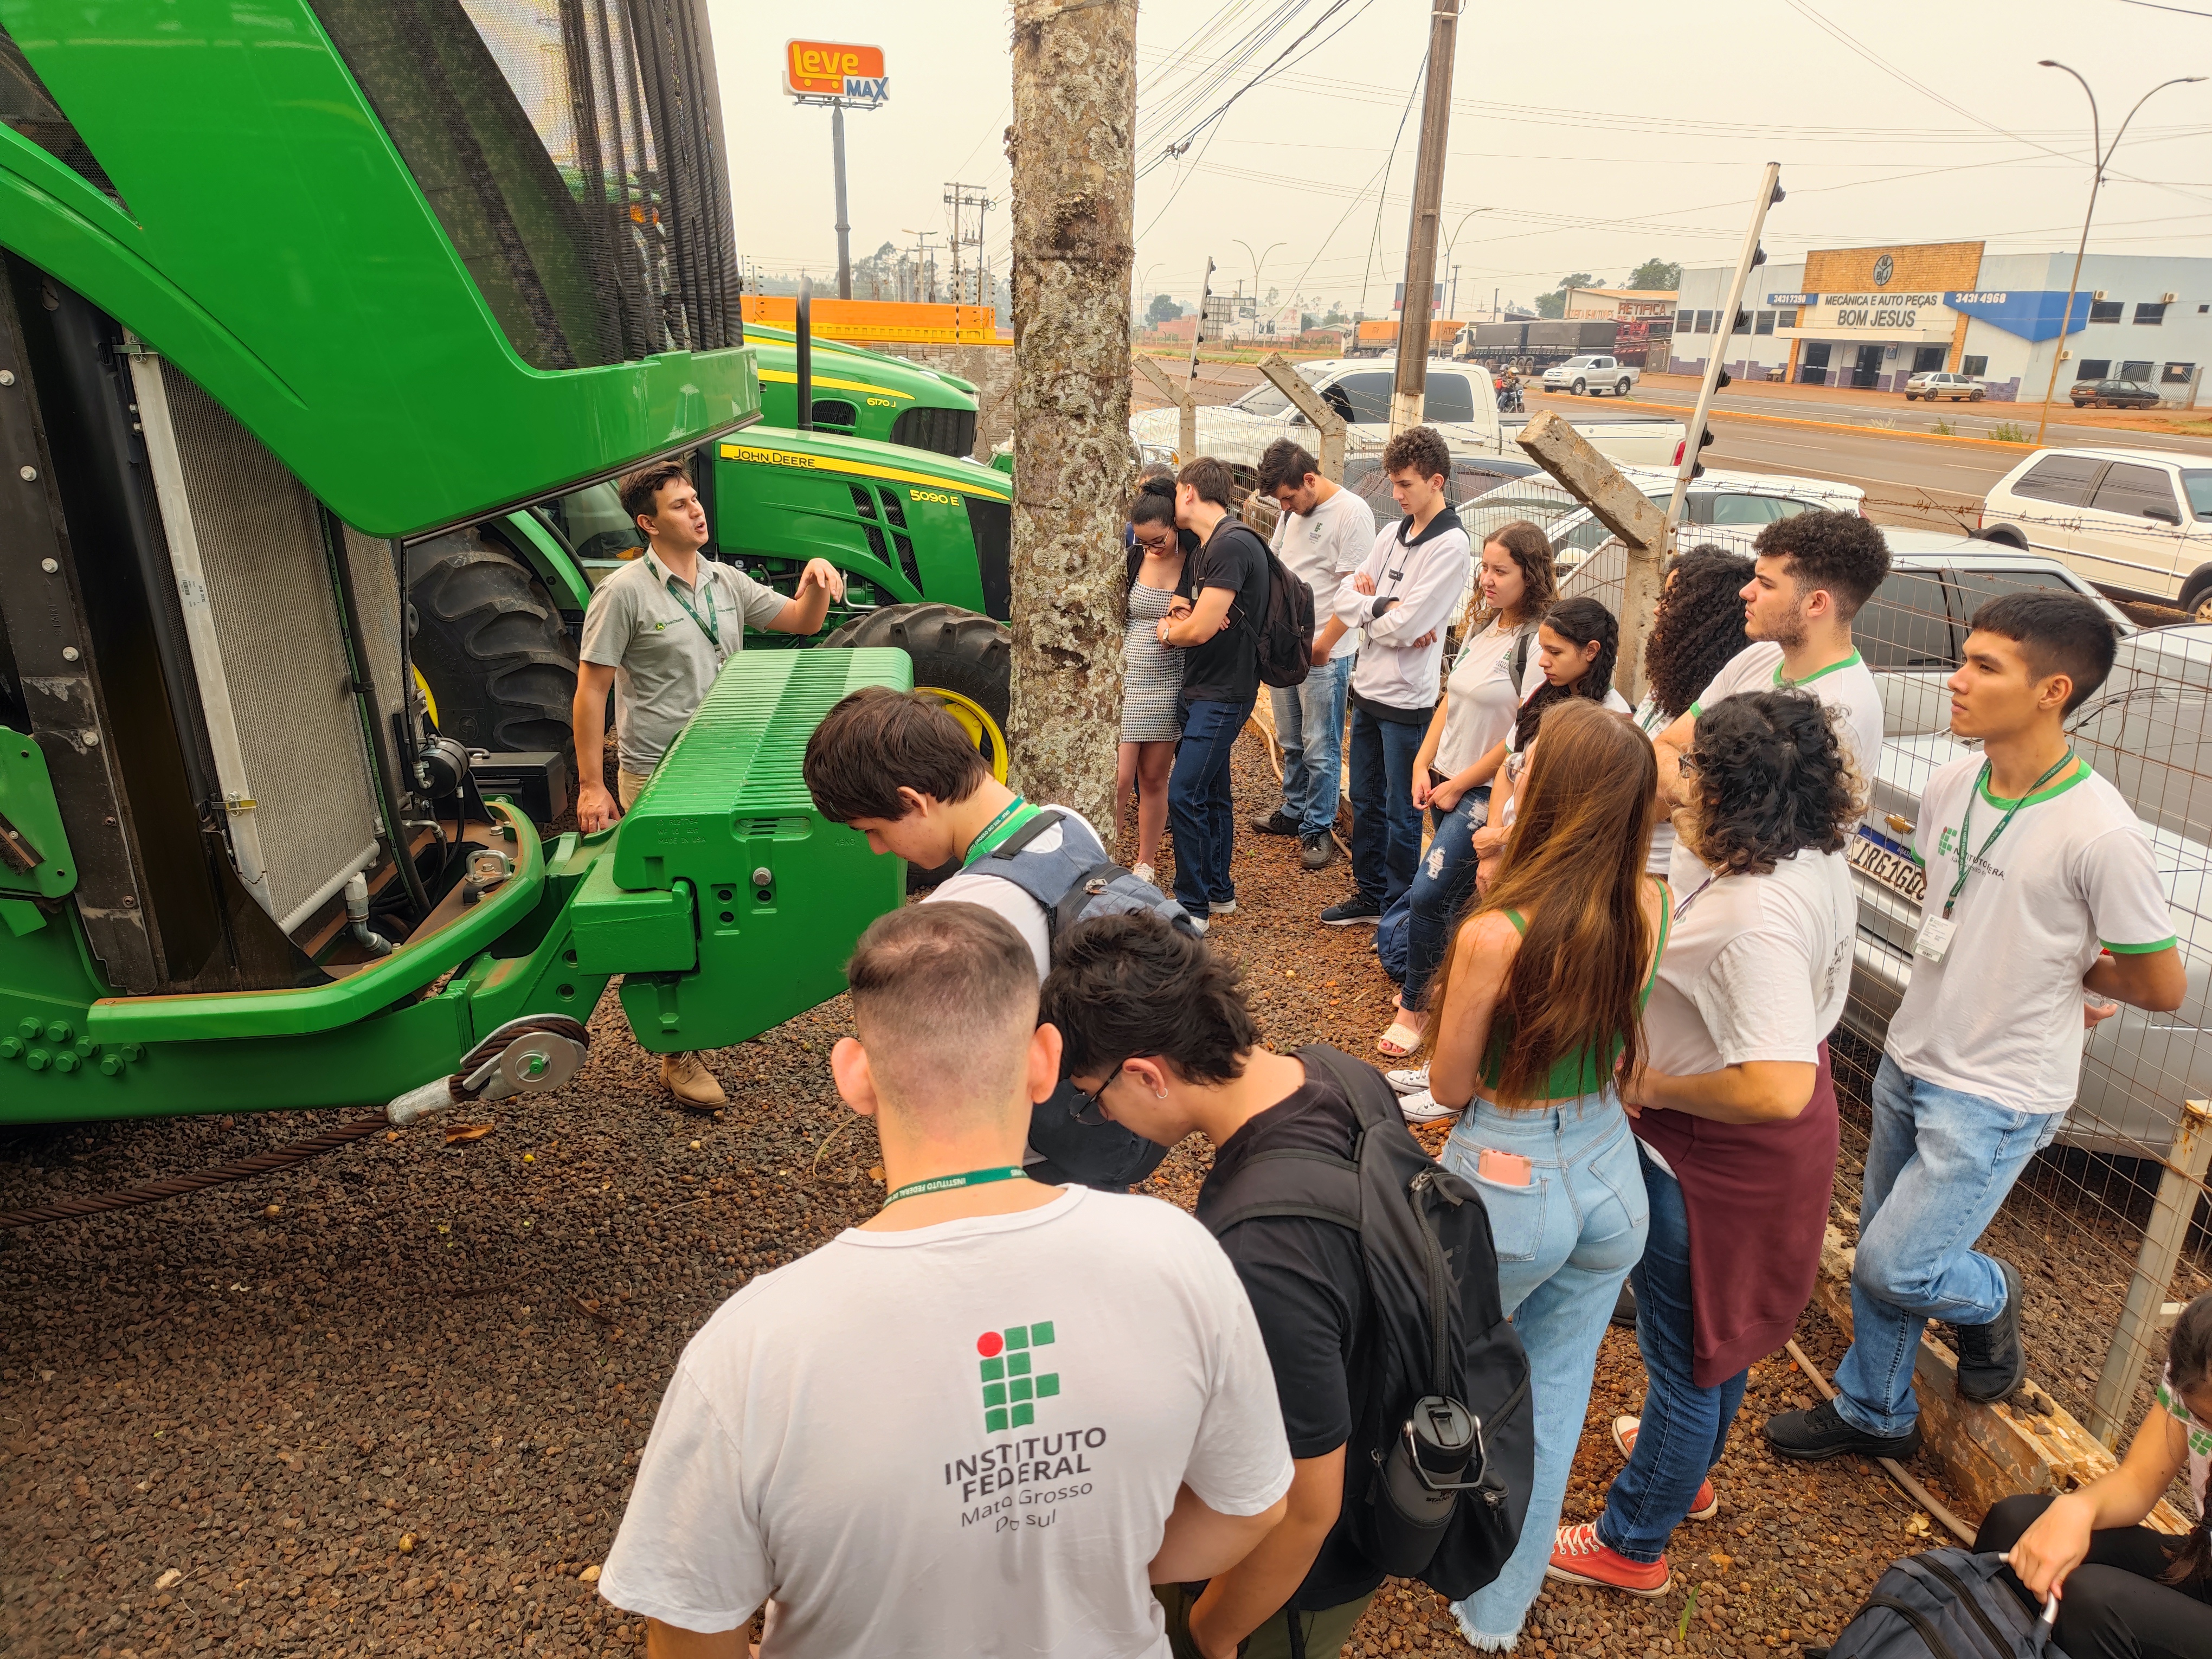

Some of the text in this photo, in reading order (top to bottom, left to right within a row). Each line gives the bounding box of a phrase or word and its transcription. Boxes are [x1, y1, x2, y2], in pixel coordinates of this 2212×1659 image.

[793, 44, 859, 80] Leve
[846, 78, 889, 102] MAX
[1825, 294, 1938, 307] MECÂNICA E AUTO PEÇAS
[1837, 310, 1916, 327] BOM JESUS
[866, 397, 890, 408] 6170
[734, 448, 815, 468] JOHN DEERE
[909, 489, 960, 506] 5090 E
[2050, 761, 2065, 774] GROSSO
[974, 829, 989, 845] GROSSO
[993, 819, 1001, 827] SUL
[899, 1184, 925, 1198] FEDERAL
[927, 1177, 966, 1191] INSTITUTO
[945, 1427, 1106, 1485] INSTITUTO
[962, 1454, 1091, 1503] FEDERAL
[961, 1483, 1092, 1527] Mato Grosso
